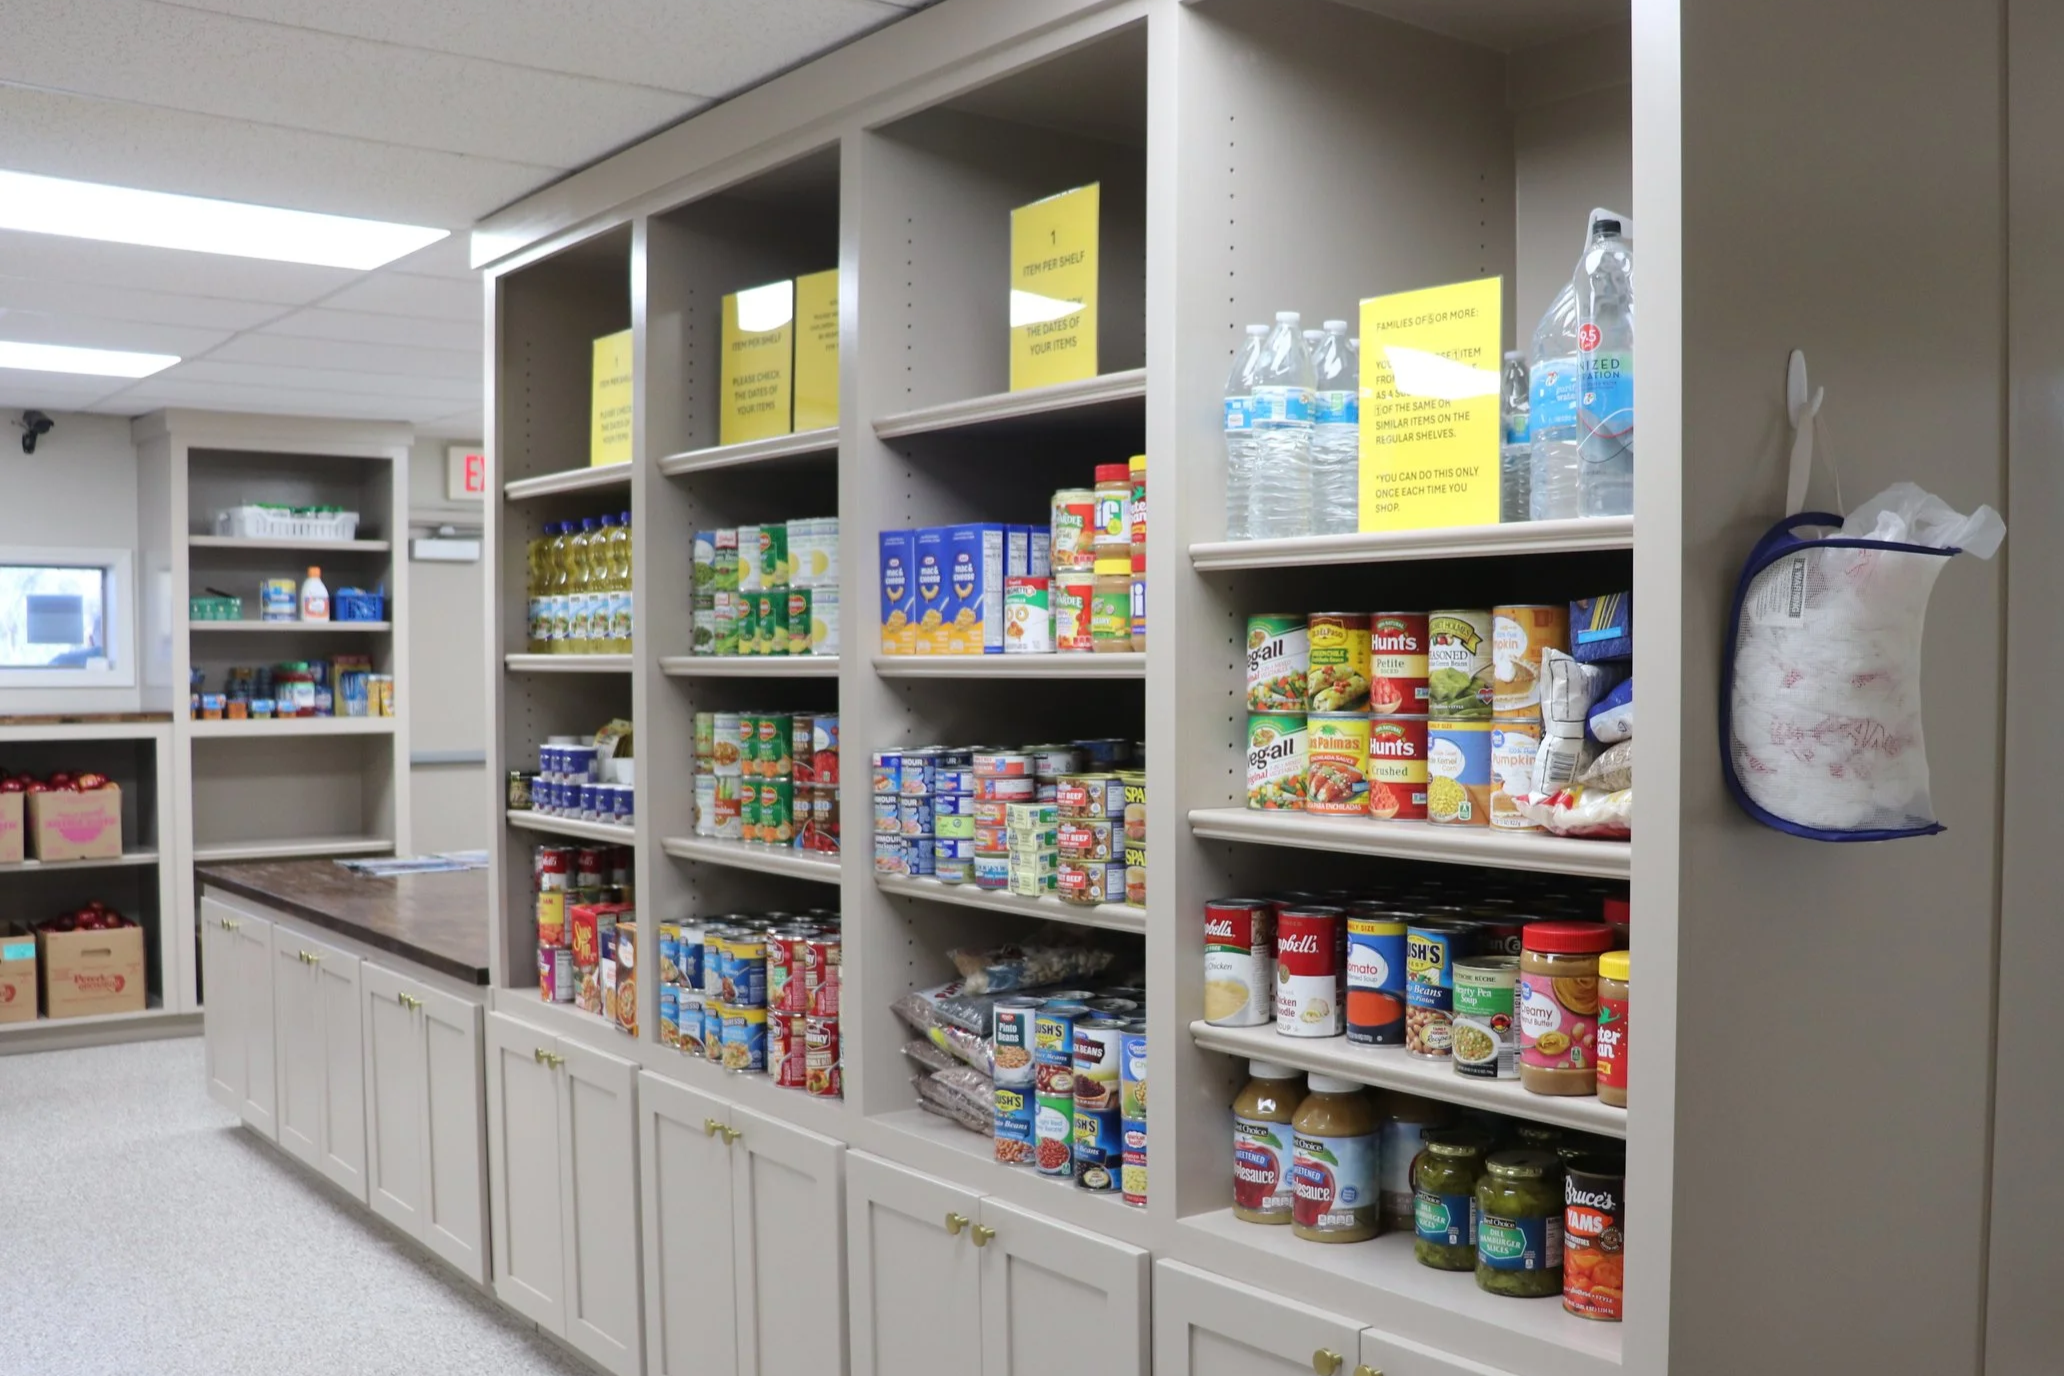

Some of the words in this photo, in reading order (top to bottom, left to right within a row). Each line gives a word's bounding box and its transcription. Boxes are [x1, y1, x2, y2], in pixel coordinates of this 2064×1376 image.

[1050, 230, 1056, 245] 1
[1023, 262, 1041, 277] ITEM
[1042, 258, 1058, 272] PER
[1059, 250, 1085, 267] SHELF
[1026, 324, 1042, 338] THE
[1043, 320, 1068, 335] DATES
[1069, 316, 1080, 330] OF
[1376, 317, 1413, 332] FAMILIES
[1415, 315, 1427, 326] OF
[1428, 314, 1434, 325] 5
[1435, 312, 1448, 323] OR
[1450, 308, 1479, 320] MORE:
[732, 340, 749, 351] ITEM
[749, 337, 759, 349] PER
[760, 332, 782, 346] SHELF
[1580, 329, 1597, 344] 9.5
[1030, 341, 1052, 356] YOUR
[1052, 336, 1077, 352] ITEMS
[1460, 347, 1482, 359] ITEM
[732, 374, 756, 387] PLEASE
[756, 370, 781, 382] CHECK
[734, 389, 749, 401] THE
[749, 387, 768, 399] DATES
[769, 385, 778, 396] OF
[737, 404, 756, 416] YOUR
[756, 400, 776, 413] ITEMS
[1382, 403, 1393, 414] OF
[1395, 402, 1411, 412] THE
[1413, 400, 1437, 411] SAME
[1376, 417, 1409, 431] SIMILAR
[1411, 414, 1436, 426] ITEMS
[1438, 412, 1451, 424] ON
[1454, 411, 1471, 422] THE
[1376, 432, 1414, 445] REGULAR
[1416, 428, 1457, 441] SHELVES.
[1399, 470, 1417, 482] CAN
[1419, 470, 1432, 480] DO
[1434, 468, 1454, 479] THIS
[1455, 466, 1479, 477] ONLY
[1375, 487, 1400, 498] ONCE
[1401, 486, 1425, 497] EACH
[1427, 484, 1447, 494] TIME
[1449, 482, 1468, 493] YOU
[1375, 503, 1400, 513] SHOP.
[1376, 658, 1405, 668] Petite
[1317, 737, 1360, 750] Palmas
[1371, 766, 1408, 777] Crushed
[1125, 786, 1146, 803] SPA
[1126, 849, 1146, 866] SPA
[1360, 924, 1375, 933] SIZE
[1347, 963, 1378, 974] omato
[1413, 984, 1443, 998] Beans
[1477, 988, 1492, 998] Pea
[1461, 994, 1478, 1006] Soup
[999, 1022, 1017, 1033] Pinto
[1534, 1018, 1553, 1027] Butter
[998, 1031, 1020, 1043] Beans
[1080, 1044, 1103, 1058] BEANS
[1242, 1125, 1267, 1136] Choice
[1300, 1139, 1323, 1152] Choice
[1565, 1174, 1616, 1210] Bruce's
[1494, 1218, 1515, 1228] Choice
[1567, 1208, 1603, 1233] YAMS
[1490, 1229, 1504, 1238] DILL
[1486, 1244, 1510, 1254] SLICES
